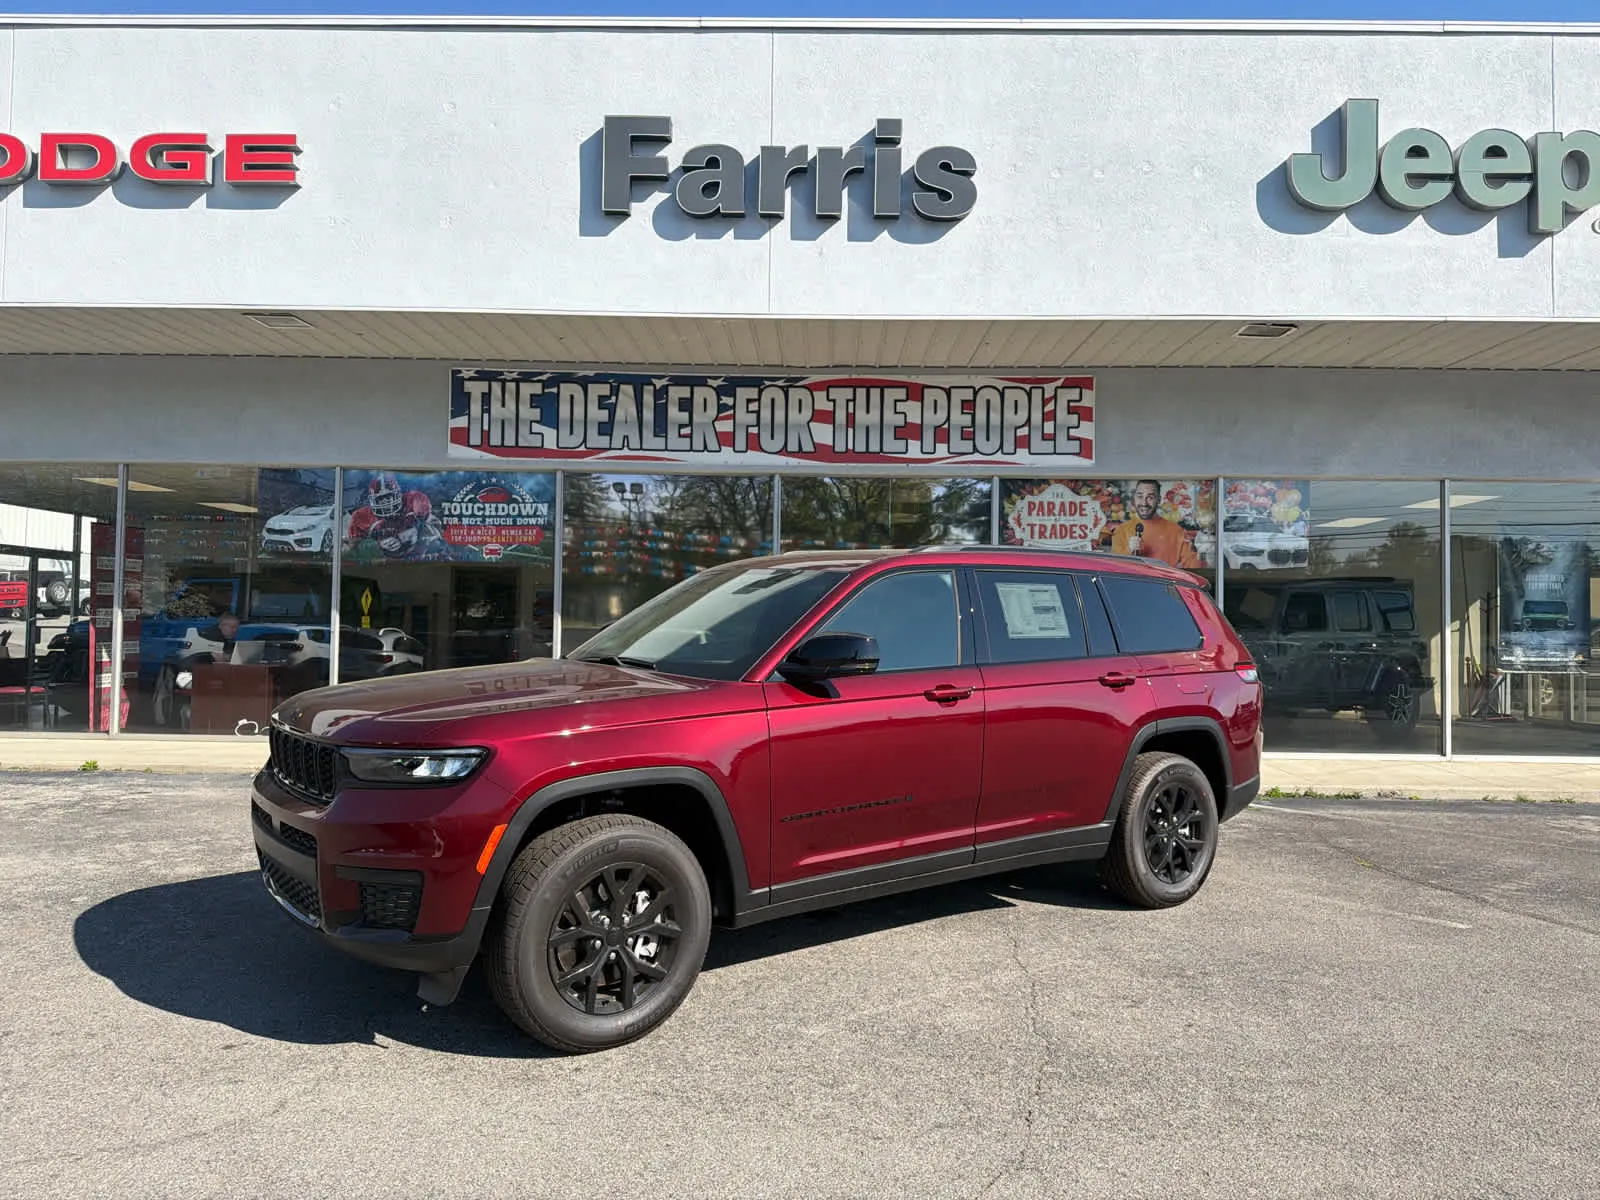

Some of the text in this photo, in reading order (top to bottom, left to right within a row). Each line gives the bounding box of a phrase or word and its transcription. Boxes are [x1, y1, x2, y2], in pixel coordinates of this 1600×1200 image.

[602, 114, 978, 221] Farris
[1288, 98, 1600, 233] Jeep
[462, 379, 1082, 455] THE DEALER FOR THE PEOPLE
[441, 502, 549, 516] TOUCHDOWN
[1027, 501, 1089, 517] PARADE
[443, 517, 548, 525] FOR NOT MUCH DOWN!
[1026, 523, 1089, 540] TRADES
